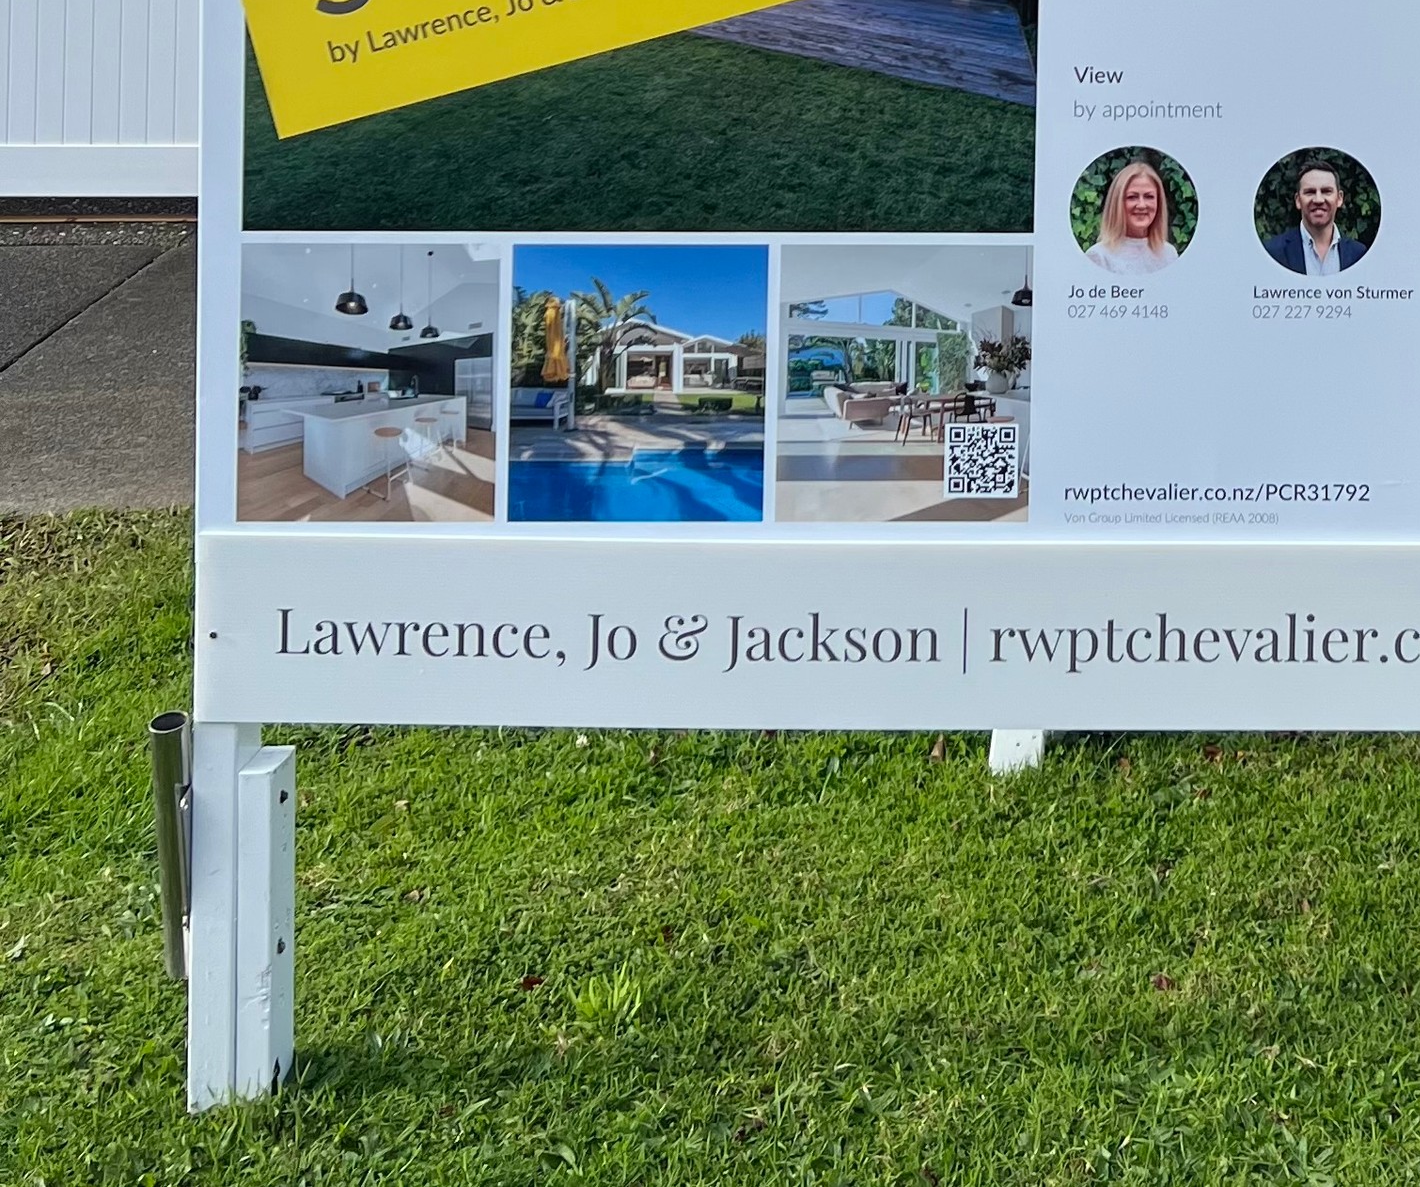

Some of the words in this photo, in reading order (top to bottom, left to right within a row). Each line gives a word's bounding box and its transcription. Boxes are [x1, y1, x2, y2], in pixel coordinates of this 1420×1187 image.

[327, 40, 360, 64] by
[367, 4, 500, 53] Lawrence,
[1073, 66, 1124, 84] View
[1073, 99, 1097, 122] by
[1102, 100, 1223, 122] appointment
[1068, 284, 1085, 299] Jo
[1088, 284, 1107, 299] de
[1111, 285, 1145, 299] Beer
[1253, 285, 1322, 299] Lawrence
[1325, 288, 1352, 299] von
[1356, 285, 1414, 300] Sturmer
[1067, 304, 1096, 319] 027
[1099, 304, 1128, 319] 469
[1131, 304, 1169, 319] 4148
[1252, 304, 1281, 319] 027
[1284, 304, 1312, 319] 227
[1315, 304, 1353, 319] 9294
[1064, 482, 1370, 505] rwptchevalier.co.nz/PCR31792
[1063, 512, 1086, 524] Von
[1087, 511, 1122, 525] Group
[1124, 512, 1163, 524] Limited
[1164, 512, 1210, 524] Licensed
[1212, 511, 1246, 525] (REAA
[1248, 512, 1279, 526] 2008)
[277, 609, 565, 666] Lawrence,
[584, 615, 636, 670] Jo
[659, 615, 708, 660] &
[724, 613, 940, 672] Jackson
